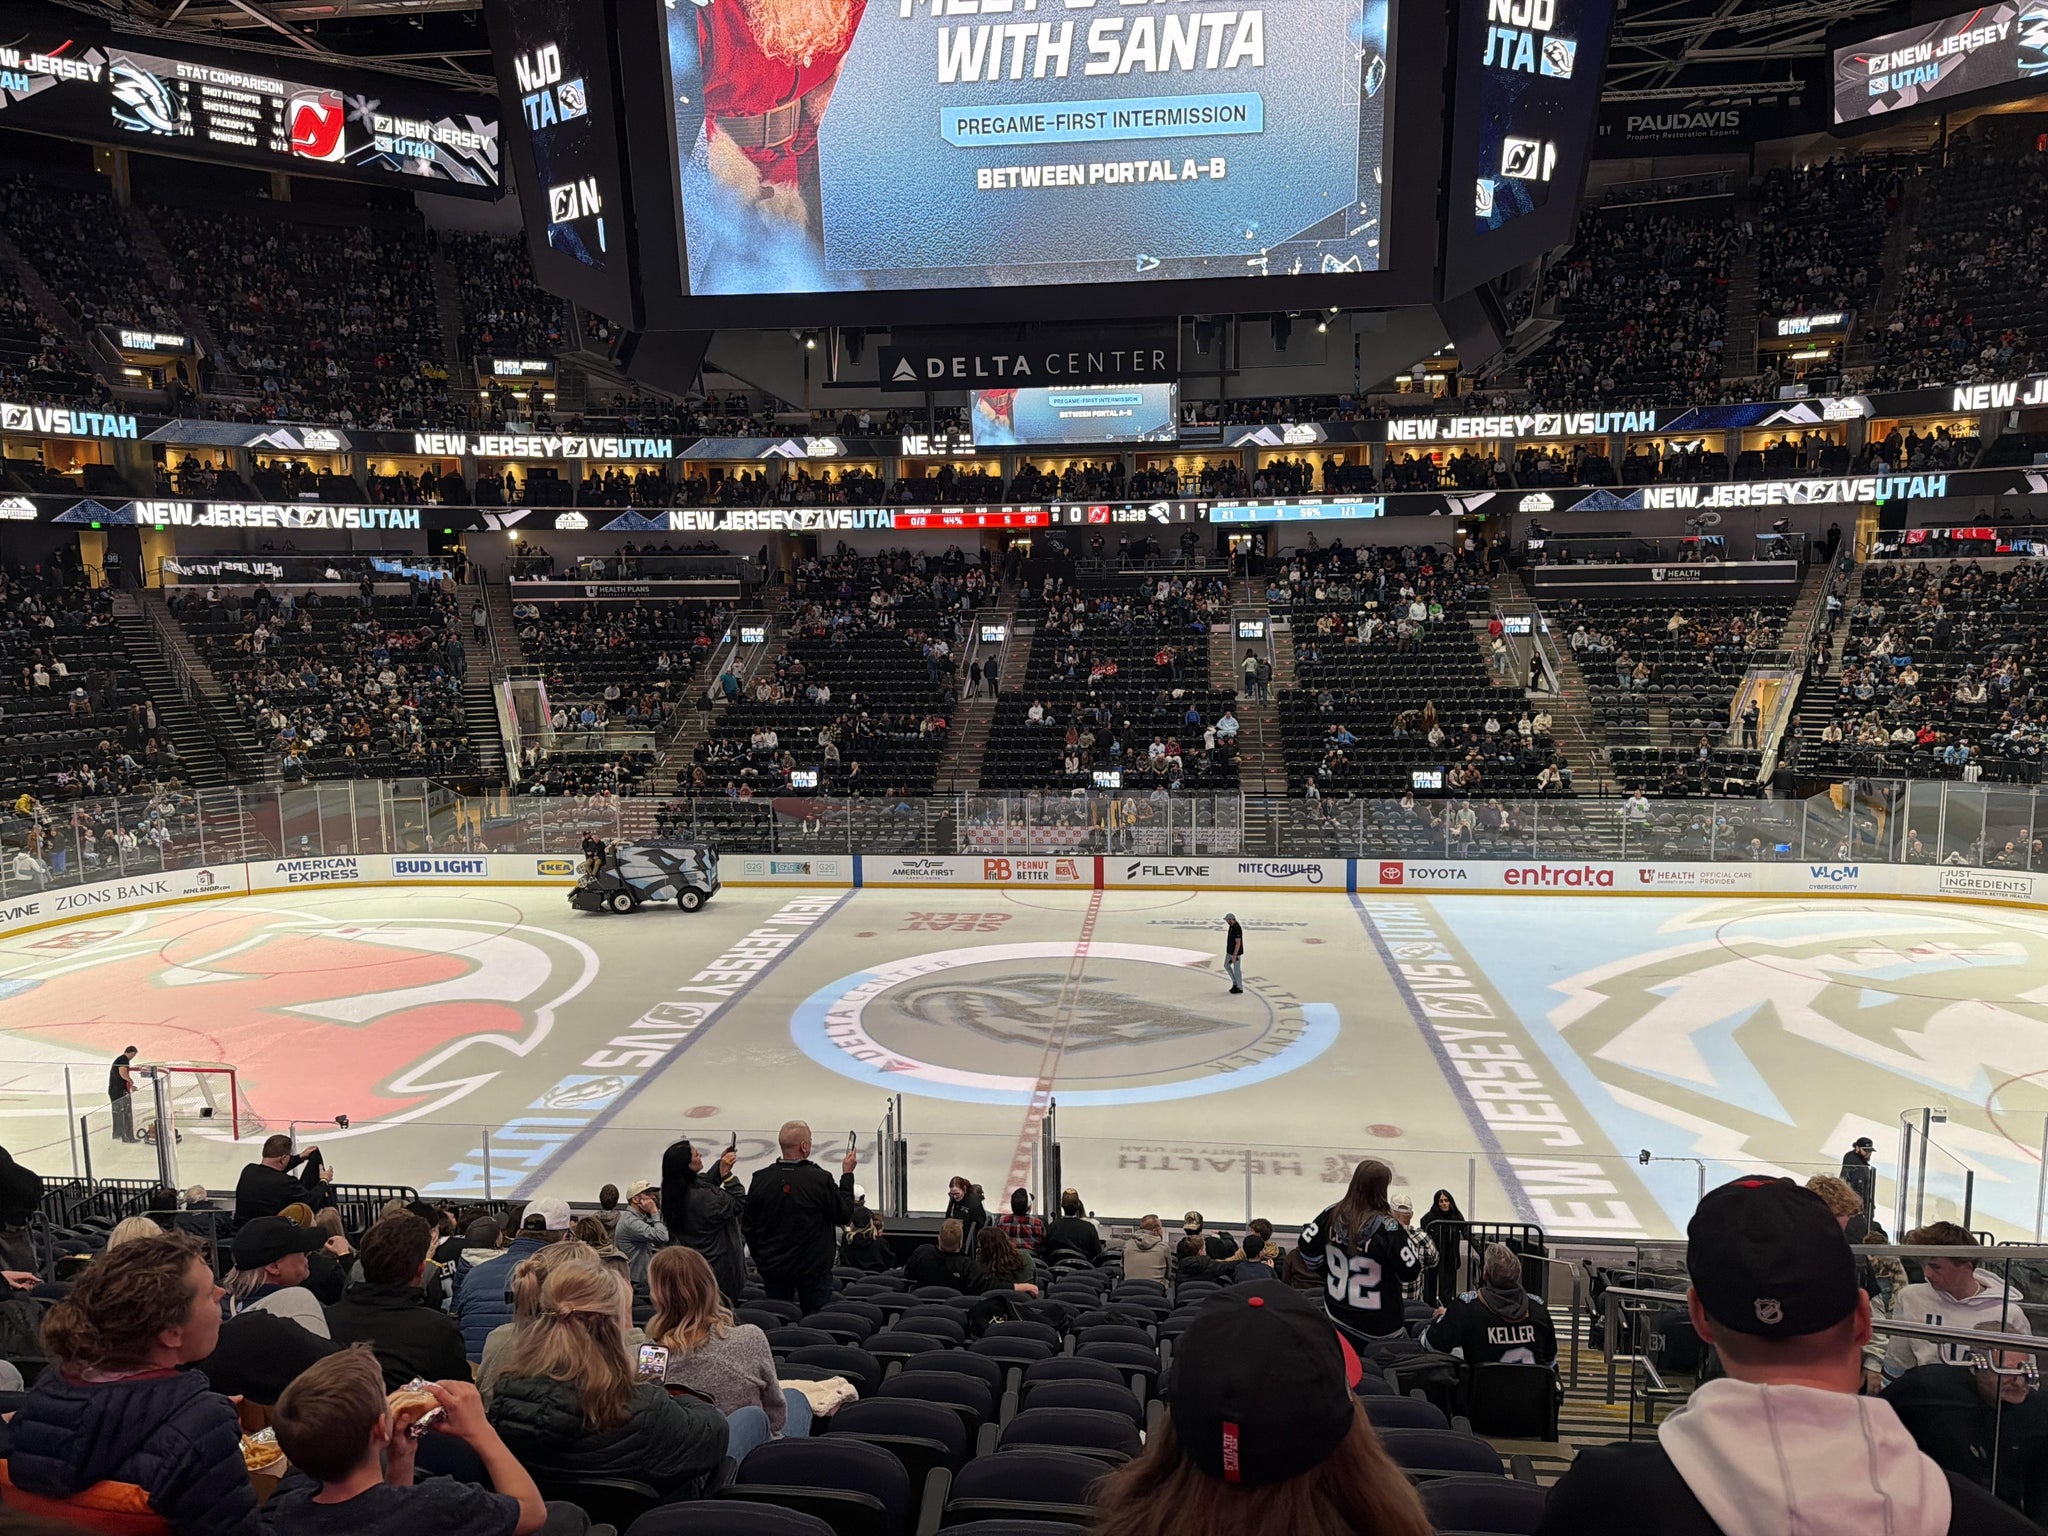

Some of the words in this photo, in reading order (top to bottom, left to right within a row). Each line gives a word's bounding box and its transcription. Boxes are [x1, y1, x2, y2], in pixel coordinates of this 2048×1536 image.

[938, 22, 1073, 83] WITH
[1085, 10, 1264, 76] SANTA
[1891, 41, 1933, 69] NEW
[1936, 21, 2011, 57] JERSEY
[24, 53, 101, 83] JERSEY
[1891, 62, 1939, 90] UTAH
[177, 64, 208, 80] STAT
[210, 70, 283, 94] COMPARISON
[180, 82, 189, 92] 21
[202, 87, 221, 98] SHOT
[222, 91, 261, 104] ATTEMPTS
[272, 100, 283, 108] 20
[203, 102, 228, 113] SHOTS
[229, 105, 240, 114] ON
[241, 107, 261, 119] GOAL
[522, 95, 558, 131] TA
[211, 118, 245, 131] FACEOFF
[273, 127, 285, 137] 44
[957, 112, 1108, 136] PREGAME-FIRST
[1112, 104, 1247, 128] INTERMISSION
[395, 121, 430, 139] NEW
[433, 129, 490, 150] JERSEY
[1627, 133, 1660, 141] Property
[1663, 130, 1707, 139] Restoration
[1710, 129, 1739, 137] Experts
[395, 142, 436, 160] UTAH
[977, 162, 1085, 190] BETWEEN
[1089, 159, 1177, 185] PORTAL
[1182, 157, 1226, 180] A-B
[1789, 317, 1807, 327] NEW
[1808, 313, 1842, 325] JERSEY
[1788, 325, 1811, 334] UTAH
[133, 332, 151, 343] NEW
[153, 335, 184, 346] JERSEY
[133, 341, 155, 350] UTAH
[520, 361, 547, 371] JERSEY
[926, 355, 1031, 379] DELTA
[1045, 350, 1166, 374] CENTER
[1098, 396, 1138, 404] INTERMISSION
[1953, 382, 2017, 411] NEW
[1092, 410, 1117, 418] PORTAL
[1388, 419, 1438, 441] NEW
[1442, 415, 1529, 439] JERSEY
[415, 434, 466, 455] NEW
[471, 436, 558, 457] JERSEY
[902, 436, 946, 455] NEW
[1644, 486, 1699, 509] NEW
[1702, 481, 1799, 507] JERSEY
[137, 501, 192, 526] NEW
[200, 504, 292, 528] JERSEY
[669, 510, 714, 530] NEW
[719, 510, 799, 531] JERSEY
[943, 516, 962, 525] 44%
[1025, 516, 1036, 524] 20
[1052, 513, 1059, 522] 9
[1070, 506, 1081, 523] 0
[1112, 509, 1146, 522] 13:28
[1178, 504, 1186, 520] 1
[1199, 510, 1206, 519] 7
[1222, 510, 1233, 519] 21
[910, 516, 926, 526] 0/2
[1667, 569, 1700, 577] HEALTH
[276, 858, 357, 873] AMERICAN
[396, 860, 432, 873] BUD
[434, 860, 484, 873] LIGHT
[539, 862, 573, 873] IKEA
[892, 868, 929, 877] AMERICA
[930, 869, 955, 877] FIRST
[1016, 860, 1049, 870] PEANUT
[1143, 865, 1210, 877] FILEVINE
[288, 869, 359, 883] EXPRESS
[1016, 871, 1049, 880] BETTER
[1408, 868, 1467, 880] TOYOTA
[1504, 865, 1614, 887] entrata
[1657, 872, 1695, 880] HEALTH
[1945, 870, 1971, 878] JUST
[1945, 878, 2027, 892] INGREDIENTS
[55, 889, 111, 911] ZIONS
[117, 880, 169, 899] BANK
[905, 911, 1013, 922] GEEK
[898, 921, 1001, 931] SEAT
[678, 928, 800, 996] JERSEY
[839, 960, 957, 1001] CENTER
[824, 1009, 884, 1061] DELTA
[1204, 1018, 1310, 1073] CENTER
[1433, 1024, 1584, 1147] JERSEY
[1118, 1154, 1303, 1177] HEALTH
[1326, 1242, 1382, 1310] 92
[1487, 1325, 1535, 1344] KELLER
[1223, 1434, 1234, 1471] DEVILS
